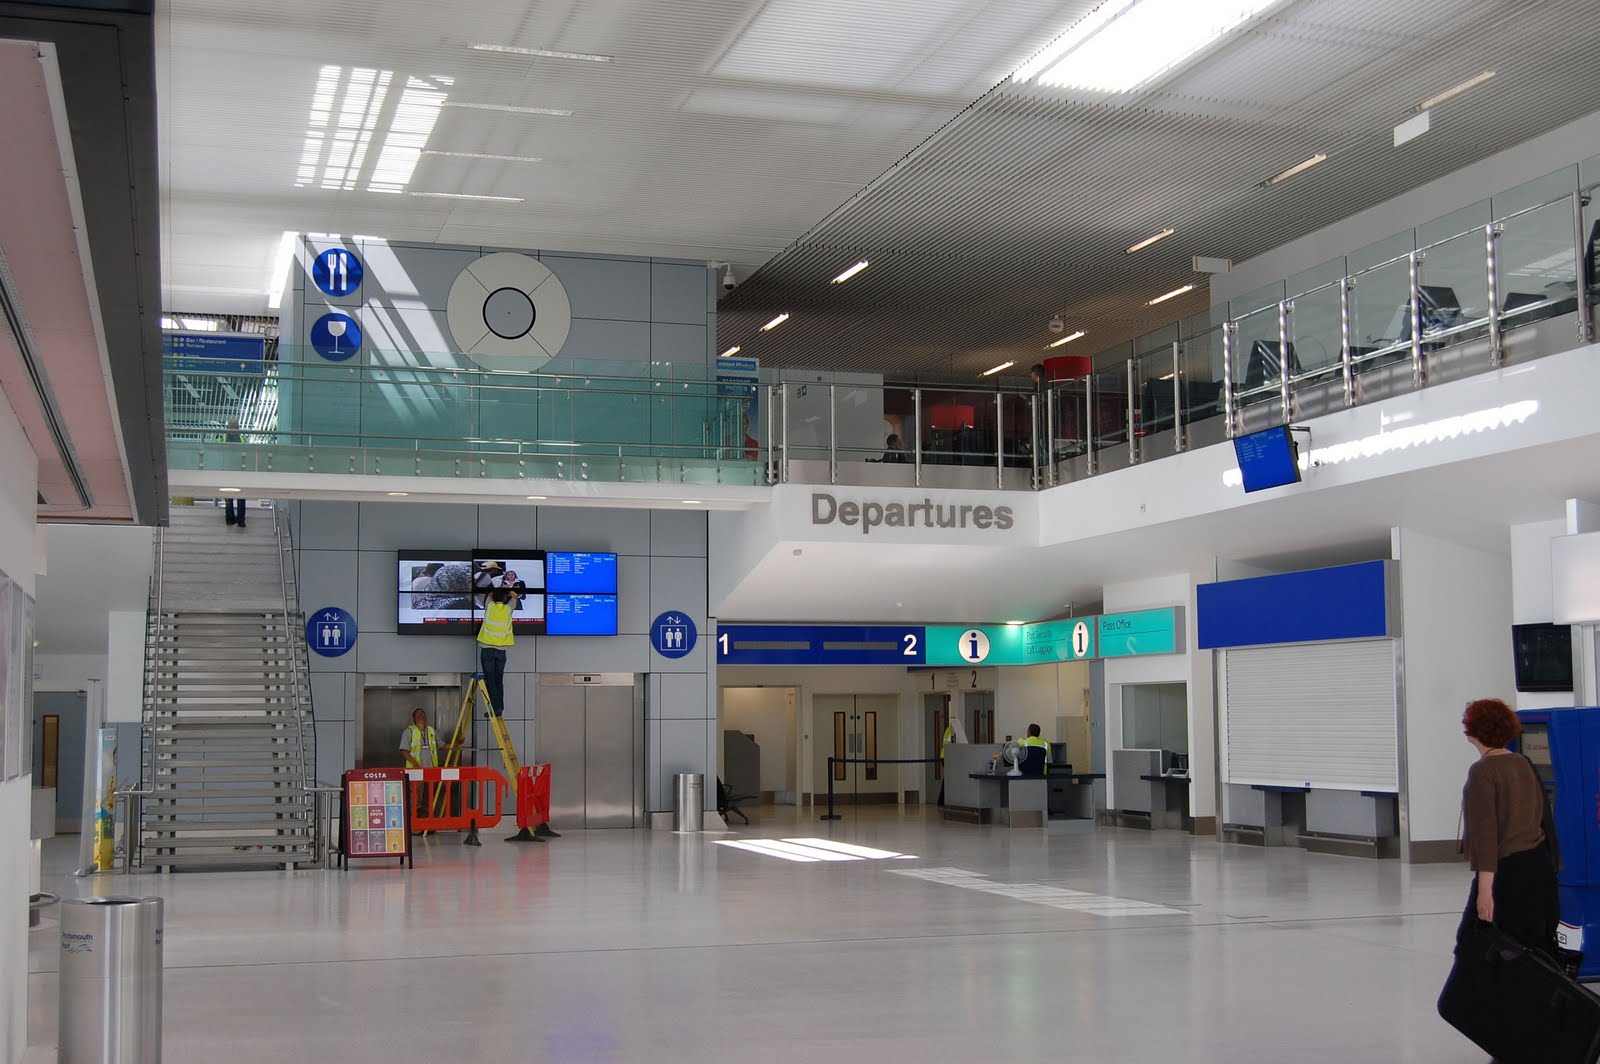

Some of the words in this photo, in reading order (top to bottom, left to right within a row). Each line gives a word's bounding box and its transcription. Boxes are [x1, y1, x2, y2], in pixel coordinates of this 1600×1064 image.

[812, 493, 1014, 534] Departures
[1102, 621, 1115, 631] Pass
[1116, 619, 1132, 630] Office
[718, 633, 729, 656] 1
[903, 634, 917, 656] 2
[930, 672, 936, 691] 1
[971, 670, 978, 689] 2
